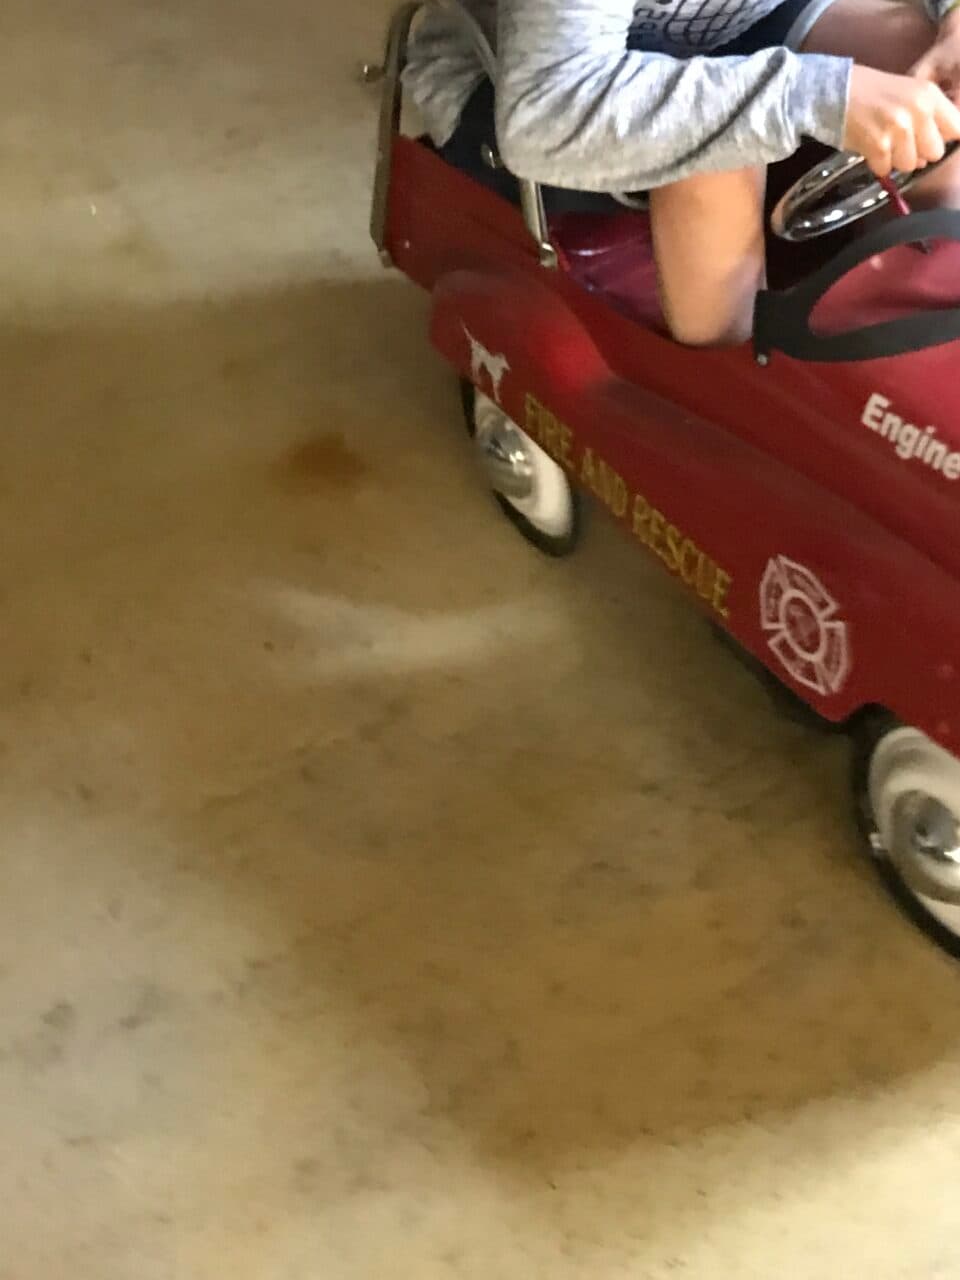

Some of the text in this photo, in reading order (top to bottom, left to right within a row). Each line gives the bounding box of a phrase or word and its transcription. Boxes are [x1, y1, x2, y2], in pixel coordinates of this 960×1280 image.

[524, 392, 733, 617] FIRE AND RESCUE
